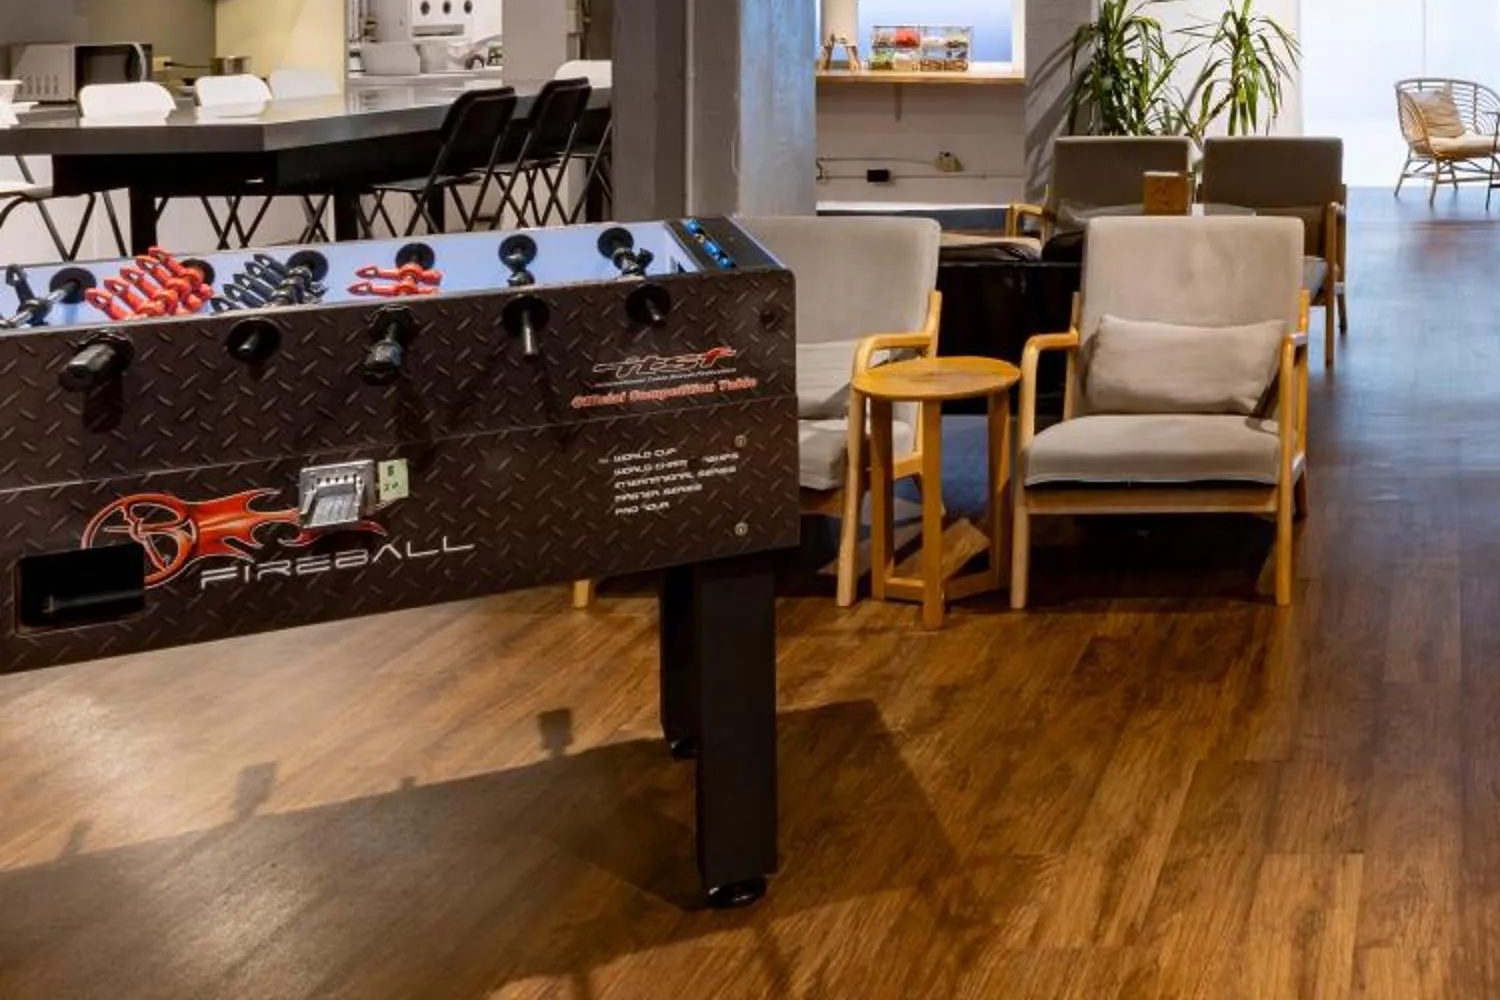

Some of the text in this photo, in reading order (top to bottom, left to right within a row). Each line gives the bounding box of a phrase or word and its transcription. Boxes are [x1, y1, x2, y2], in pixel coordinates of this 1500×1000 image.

[613, 451, 652, 462] WORLD
[613, 463, 653, 475] WORLD
[201, 536, 475, 589] FIREBALL
